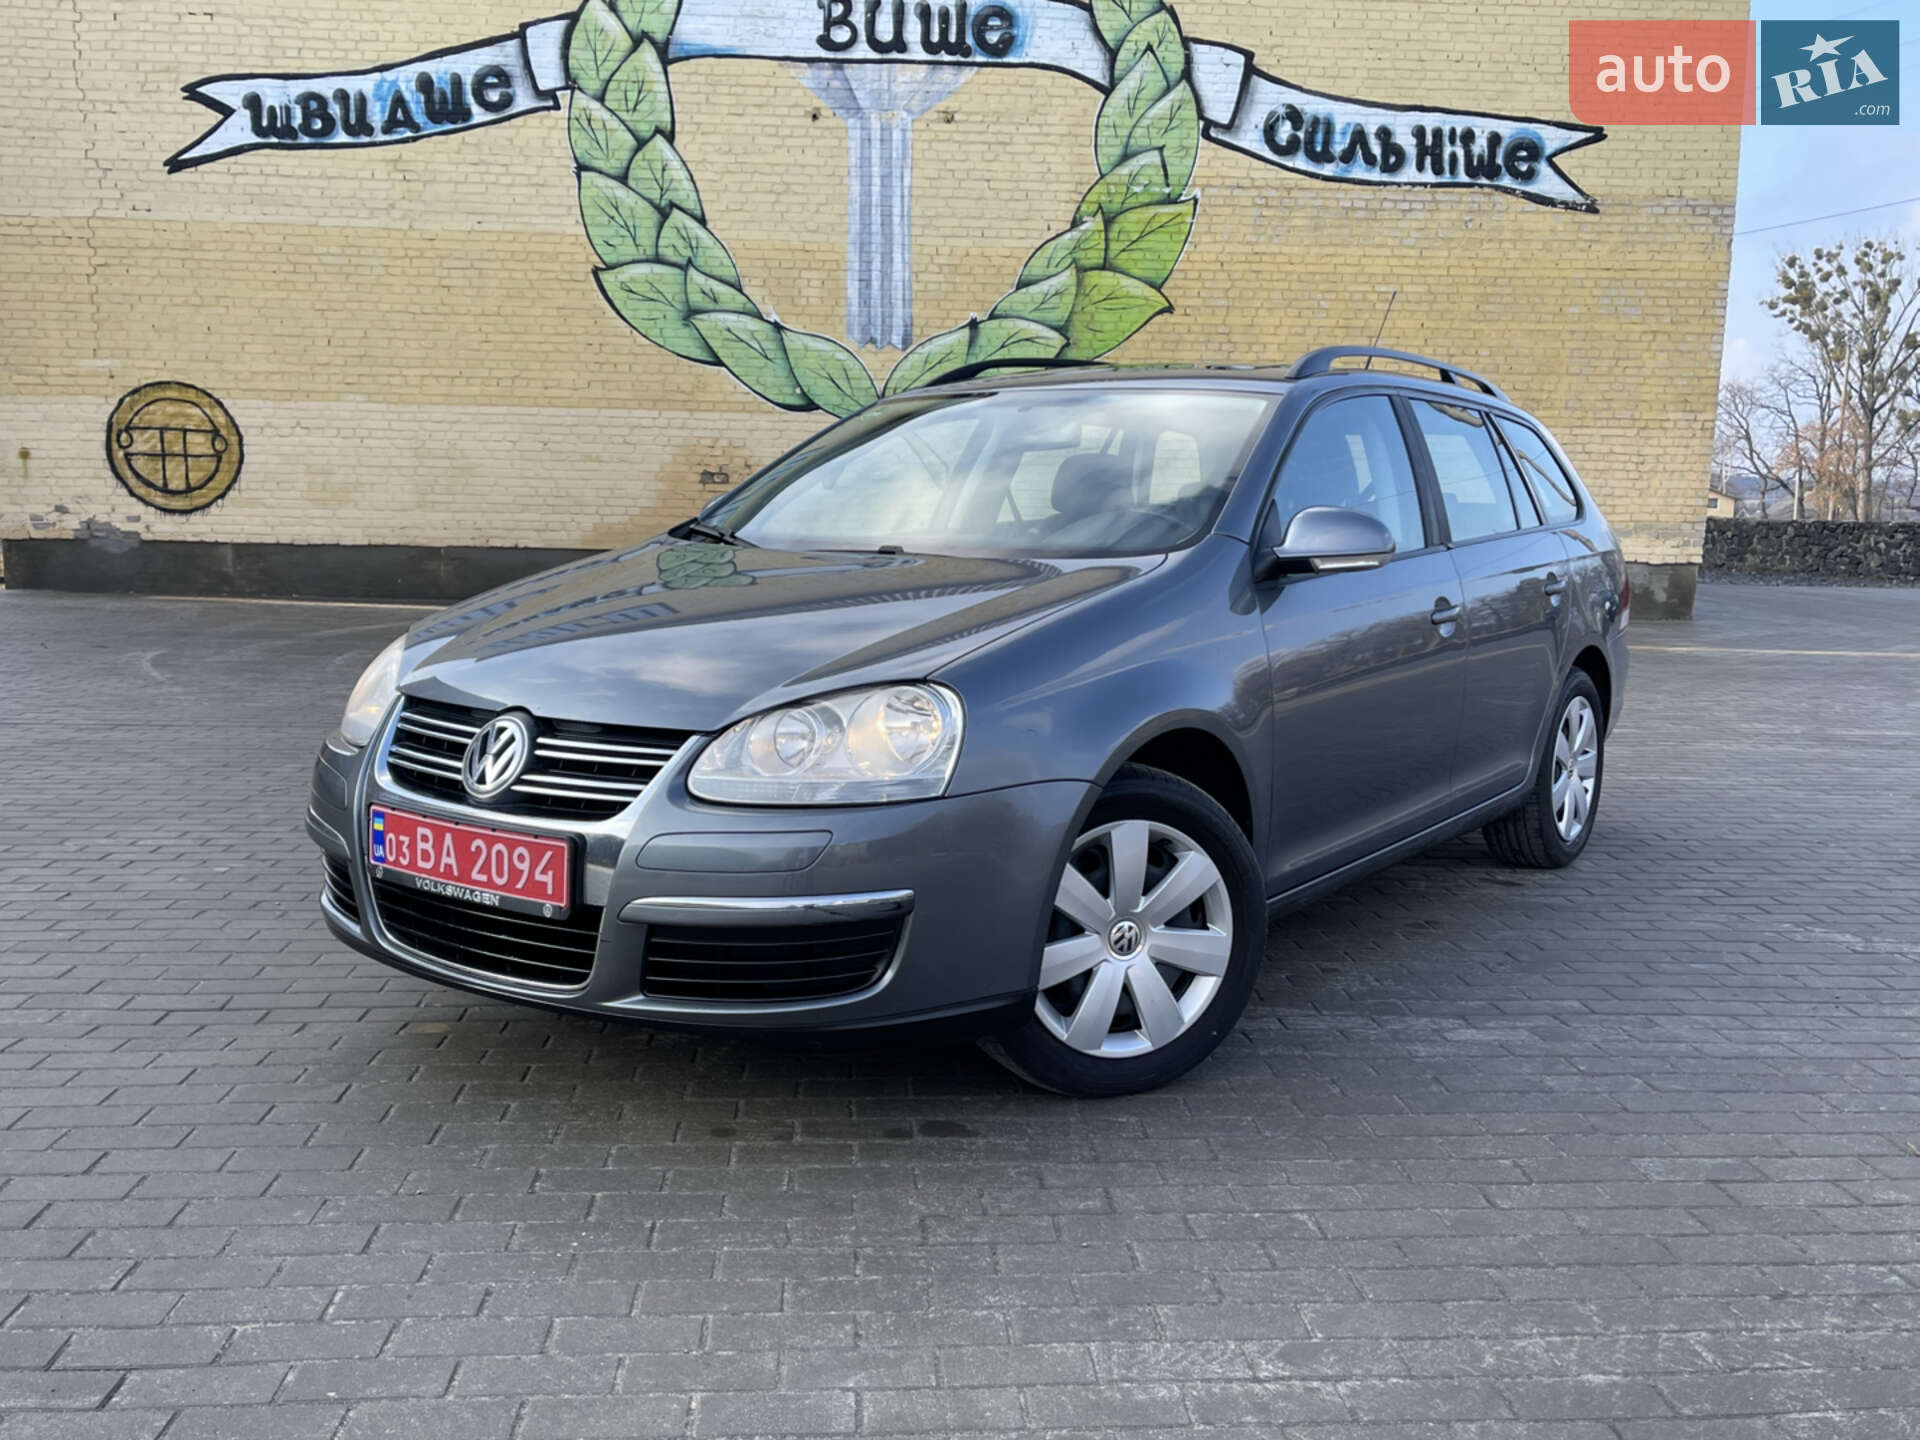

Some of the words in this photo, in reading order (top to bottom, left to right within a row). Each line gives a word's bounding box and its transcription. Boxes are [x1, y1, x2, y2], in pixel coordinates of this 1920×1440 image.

[373, 843, 385, 858] UA
[470, 838, 554, 895] 2094
[415, 876, 500, 907] VOLKSWAGEN
